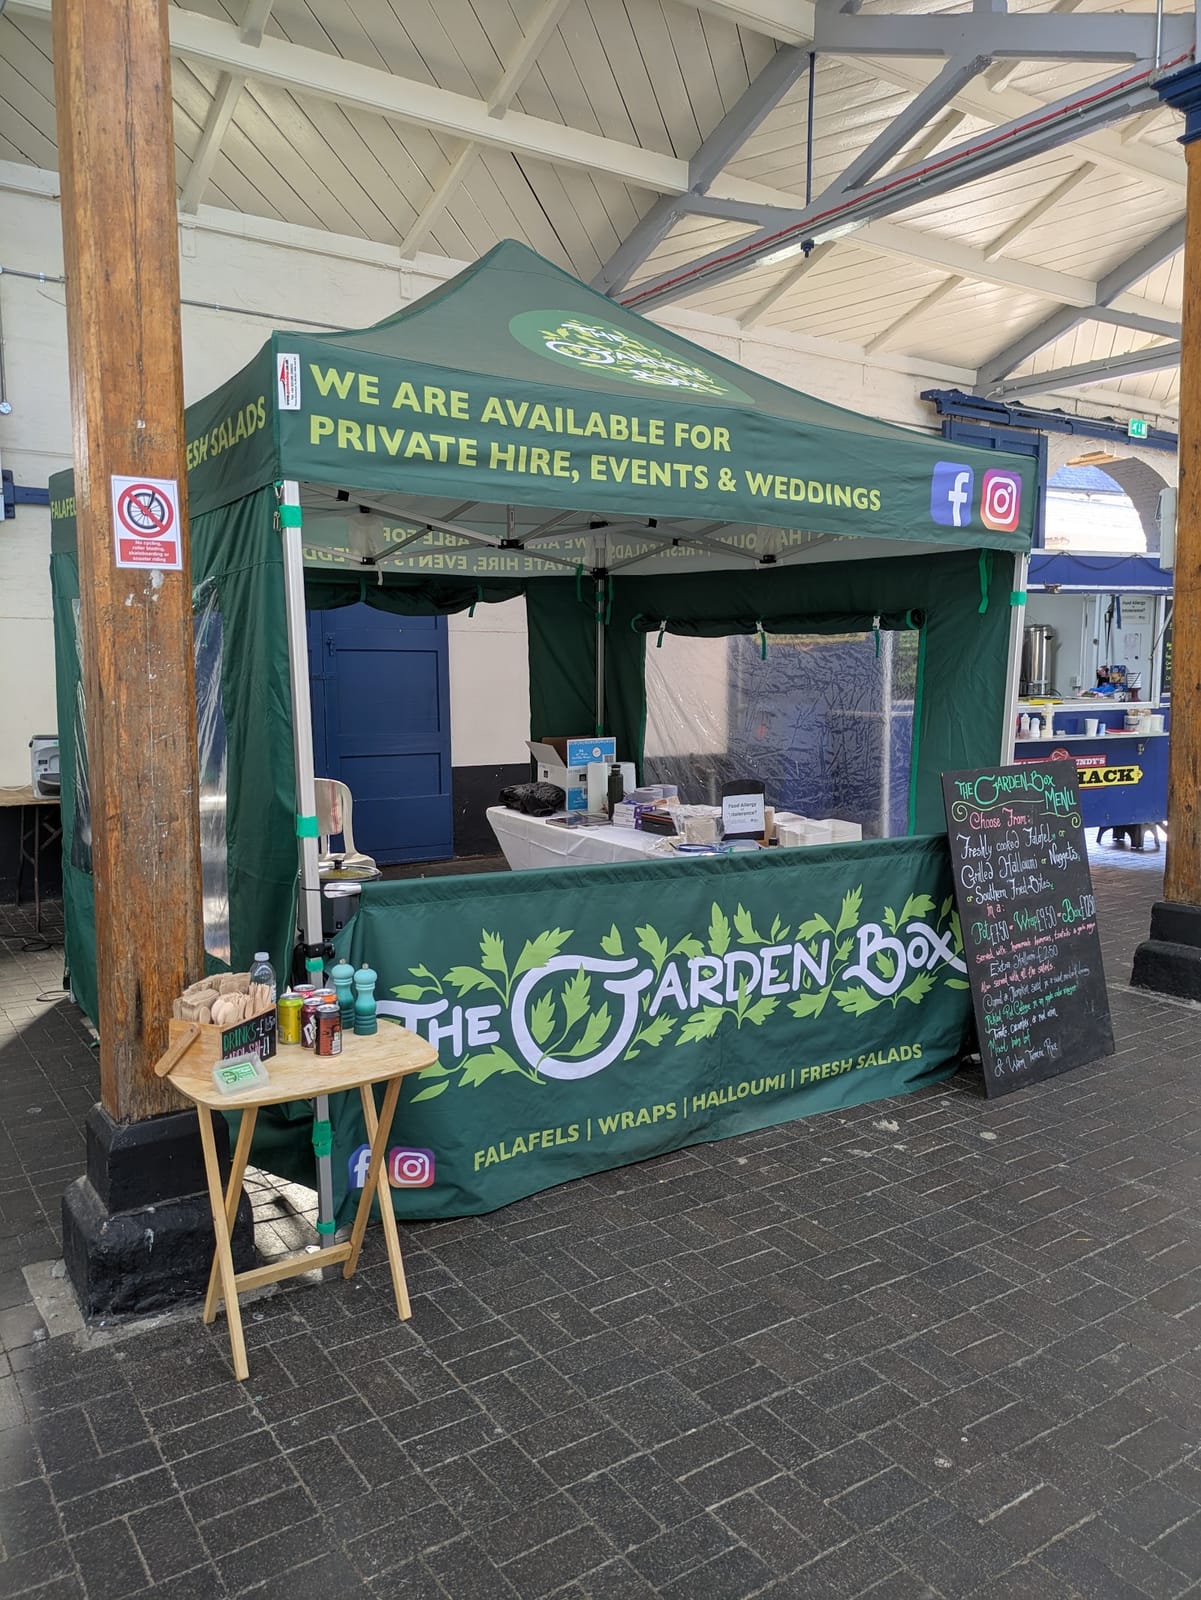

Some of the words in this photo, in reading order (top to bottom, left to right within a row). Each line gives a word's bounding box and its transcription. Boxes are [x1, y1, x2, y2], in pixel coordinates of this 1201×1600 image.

[309, 364, 380, 405] WE
[392, 382, 470, 420] ARE
[480, 397, 665, 445] AVAILABLE
[674, 422, 731, 451] FOR
[186, 434, 208, 471] ESH
[210, 395, 266, 457] SALADS
[309, 414, 478, 467] PRIVATE
[489, 442, 580, 484] HIRE,
[590, 454, 709, 490] EVENTS
[717, 467, 737, 492] &
[745, 470, 881, 511] WEDDINGS
[954, 781, 973, 799] THE
[974, 772, 1028, 805] GARDEN
[1045, 786, 1077, 815] MENU
[969, 811, 1001, 830] Choose
[956, 833, 992, 860] Freshly
[996, 830, 1020, 852] cooked
[961, 860, 993, 889] Grilled
[998, 854, 1037, 878] Halloumi
[976, 885, 1008, 904] Southern
[1007, 878, 1029, 900] Fried
[971, 921, 990, 945] Pot
[1013, 907, 1037, 932] Wrap
[990, 960, 1011, 977] Extra
[376, 999, 501, 1057] THE
[511, 939, 830, 1080] GARDEN
[994, 1058, 1005, 1077] &
[474, 1124, 580, 1172] FALAFELS
[598, 1101, 676, 1135] WRAPS
[693, 1073, 786, 1113] HALLOUMI
[800, 1058, 851, 1085] FRESH
[856, 1044, 922, 1070] SALADS
